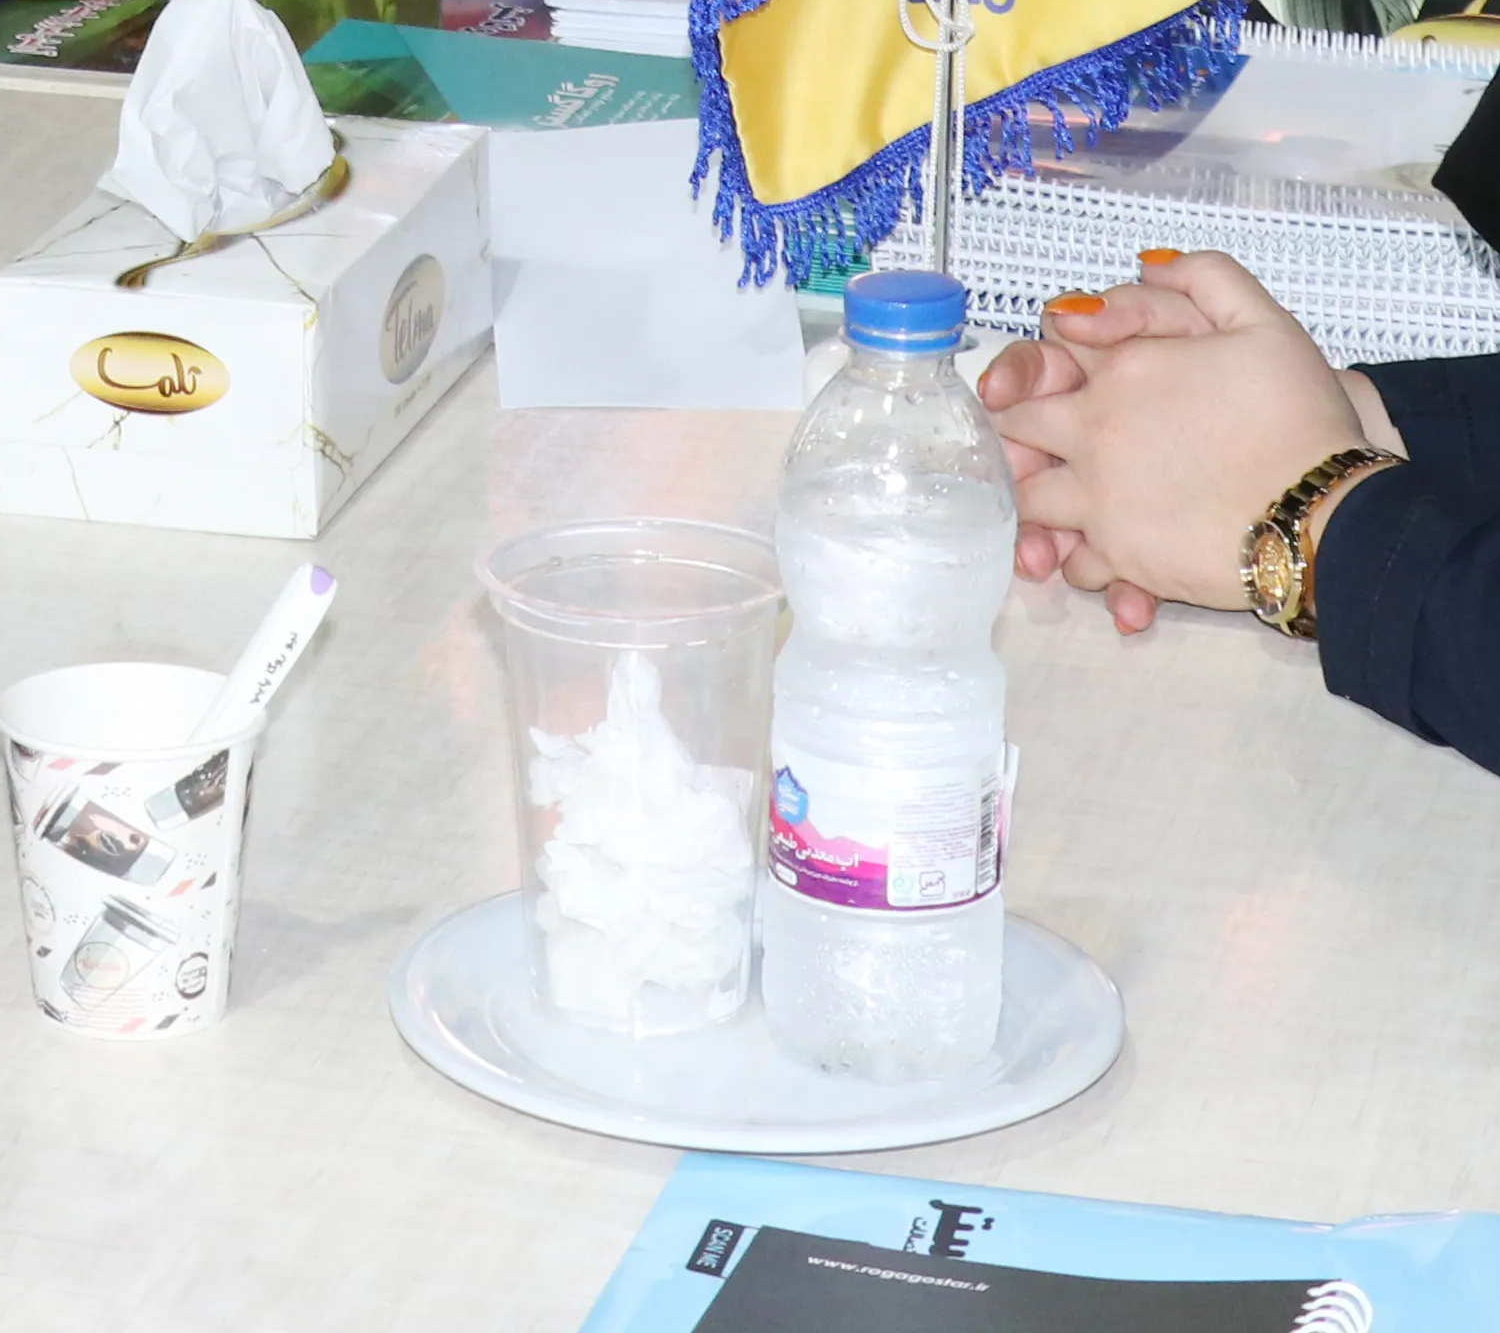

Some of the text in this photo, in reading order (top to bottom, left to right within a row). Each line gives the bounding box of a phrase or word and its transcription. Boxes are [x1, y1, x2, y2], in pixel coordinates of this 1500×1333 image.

[695, 1225, 734, 1269] SCAN ME
[805, 1253, 991, 1293] www.rogagostar.ir
